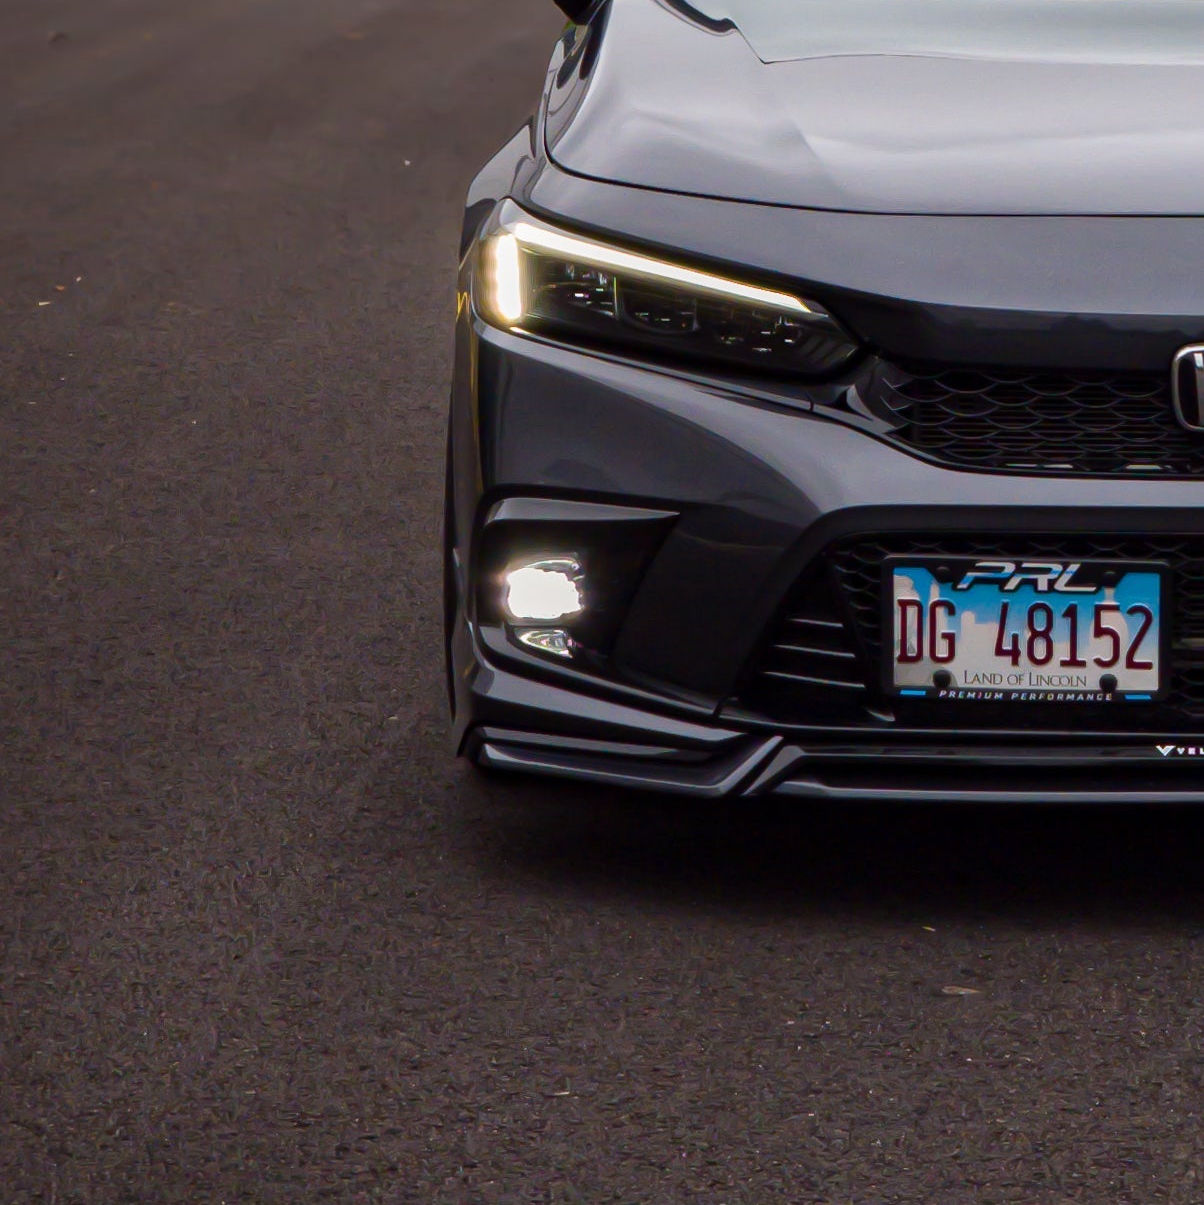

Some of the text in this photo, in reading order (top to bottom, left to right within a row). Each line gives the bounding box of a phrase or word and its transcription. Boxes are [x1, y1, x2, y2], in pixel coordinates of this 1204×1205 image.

[956, 561, 1097, 592] PRL
[897, 598, 1153, 671] DG 48152
[963, 669, 1087, 688] LAND OF LINCOLN
[938, 689, 1113, 702] PREMIUM PERFORMANCE
